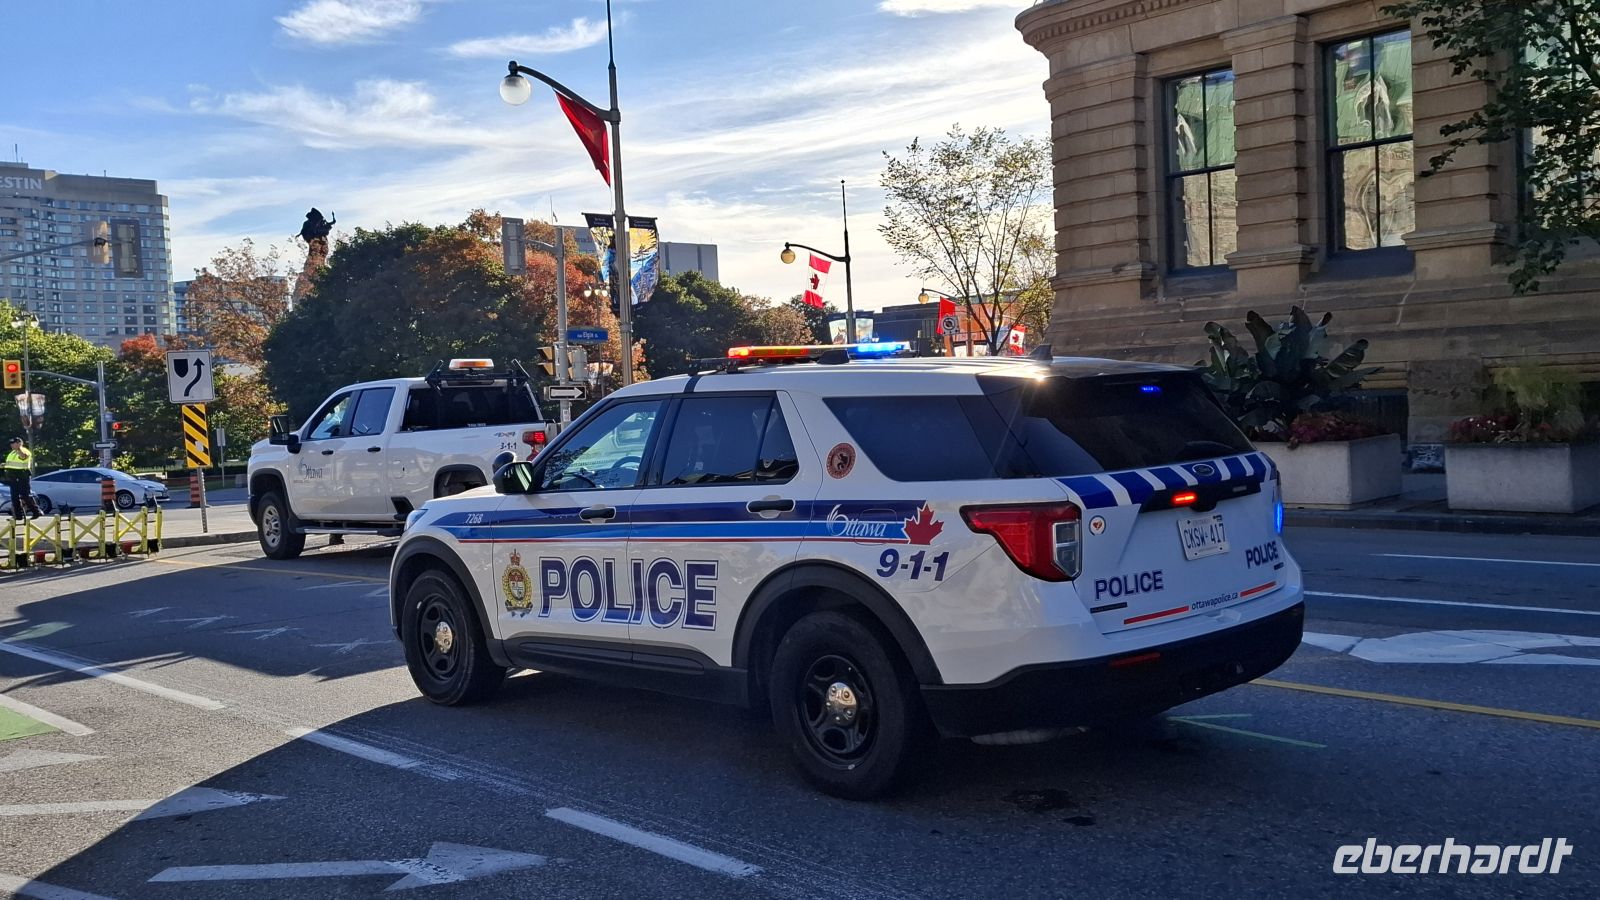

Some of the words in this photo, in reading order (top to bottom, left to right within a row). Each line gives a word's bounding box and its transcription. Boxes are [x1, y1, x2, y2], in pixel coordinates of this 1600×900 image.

[465, 513, 483, 524] 7268
[826, 504, 888, 537] Ottawa
[876, 548, 950, 582] 9-1-1
[1245, 540, 1279, 570] POLICE
[538, 555, 719, 631] POLICE
[1095, 570, 1164, 601] POLICE
[1191, 592, 1238, 610] ottawapolice.ca
